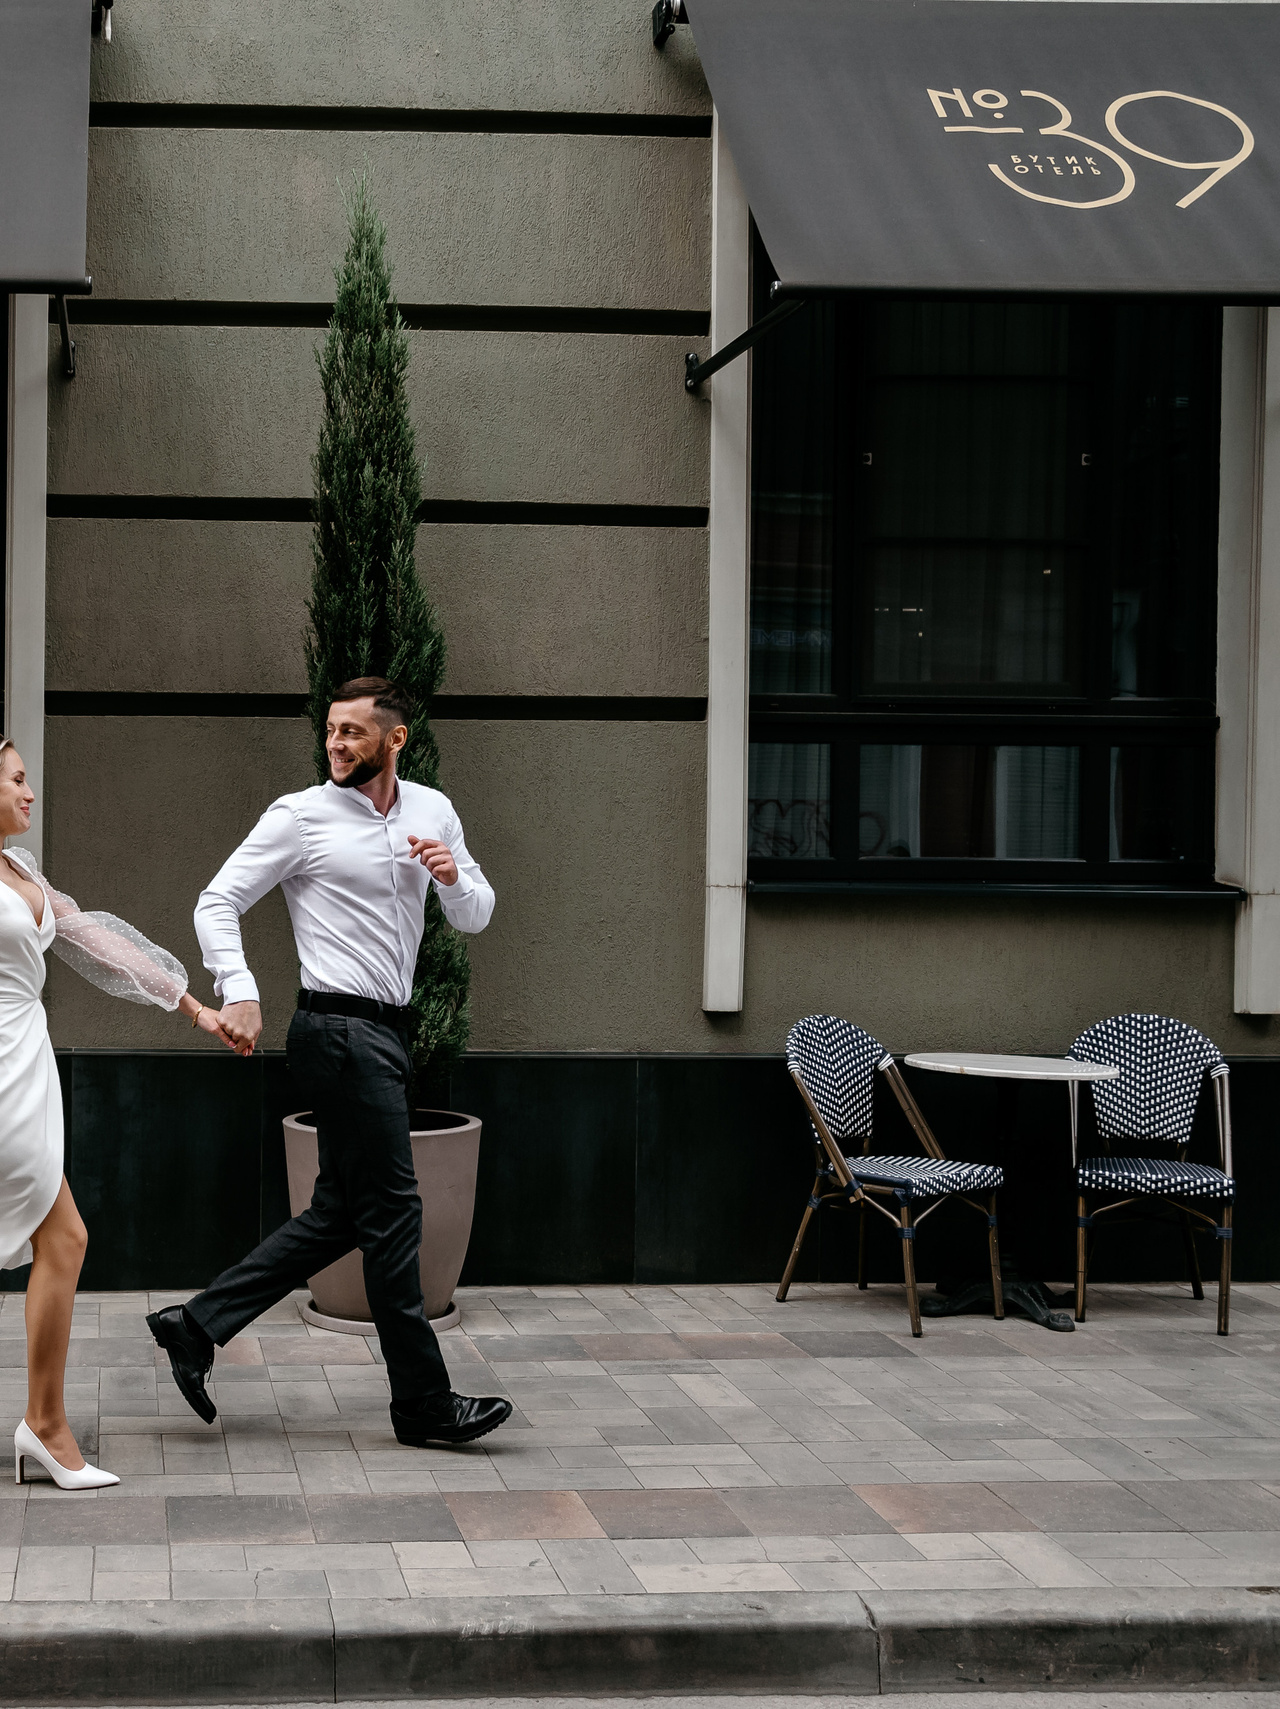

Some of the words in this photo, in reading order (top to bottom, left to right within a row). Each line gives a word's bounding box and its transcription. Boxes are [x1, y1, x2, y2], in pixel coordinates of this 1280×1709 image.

[987, 90, 1255, 209] 39
[1010, 154, 1097, 166] БУТИК
[1014, 165, 1101, 176] ОТЕЛЬ
